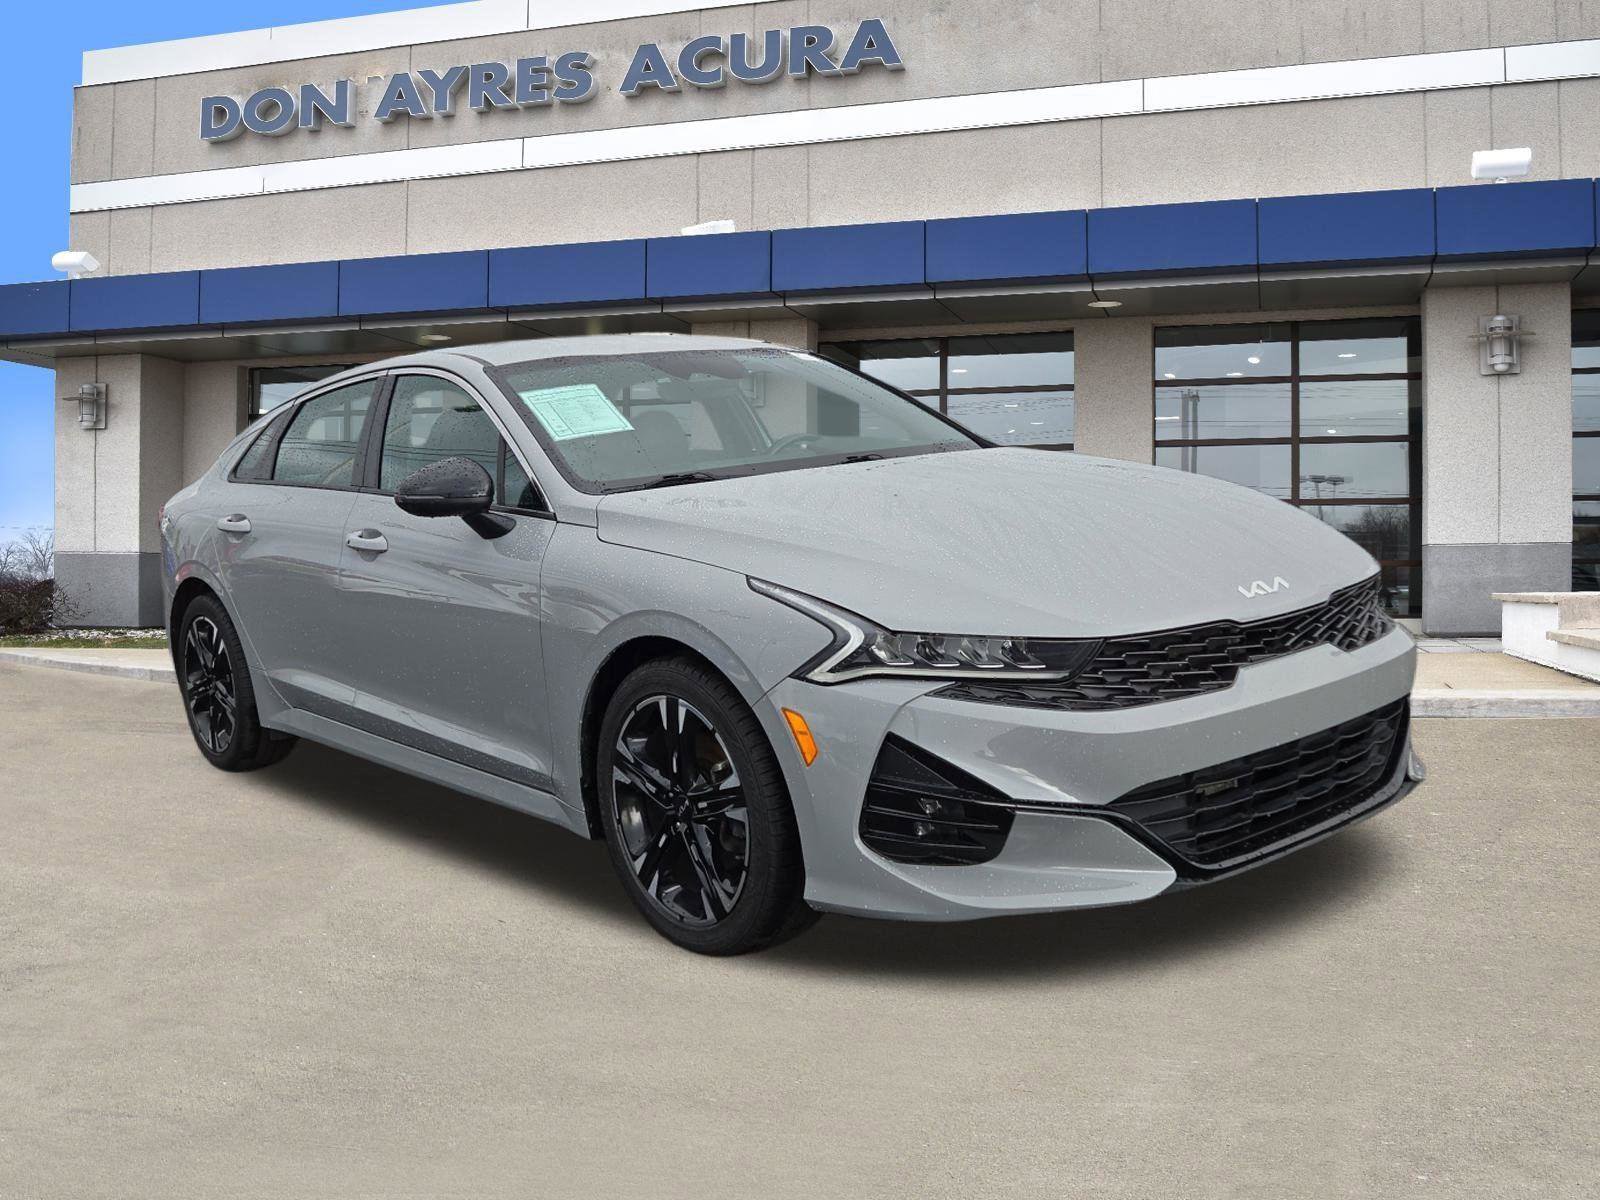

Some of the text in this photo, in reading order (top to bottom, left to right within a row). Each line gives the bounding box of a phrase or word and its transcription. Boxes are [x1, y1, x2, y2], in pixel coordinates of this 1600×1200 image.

[199, 17, 905, 143] DON AYRES ACURA
